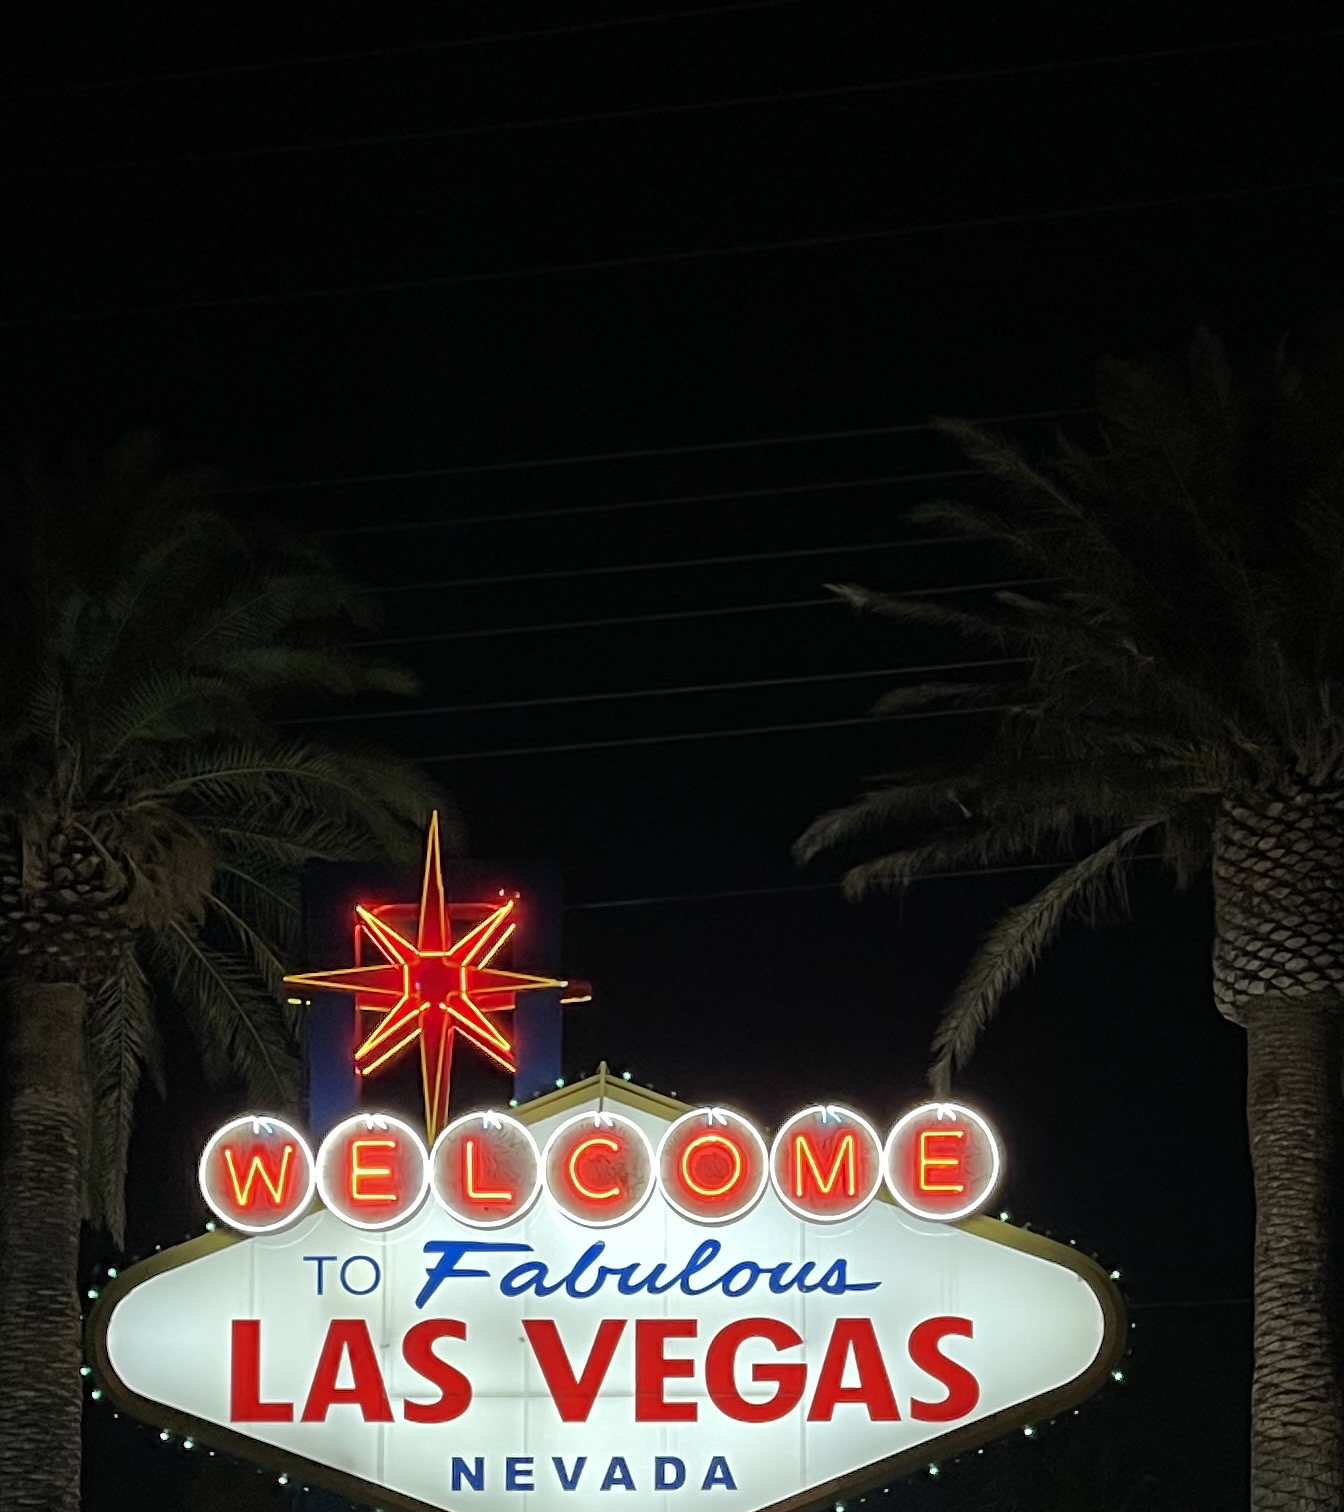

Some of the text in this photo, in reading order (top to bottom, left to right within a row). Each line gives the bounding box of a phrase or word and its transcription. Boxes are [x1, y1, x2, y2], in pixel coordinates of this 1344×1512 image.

[220, 1126, 968, 1208] WELCOME
[303, 1238, 882, 1310] TO Fabulous
[230, 1315, 981, 1425] LAS VEGAS
[451, 1455, 739, 1492] NEVADA
